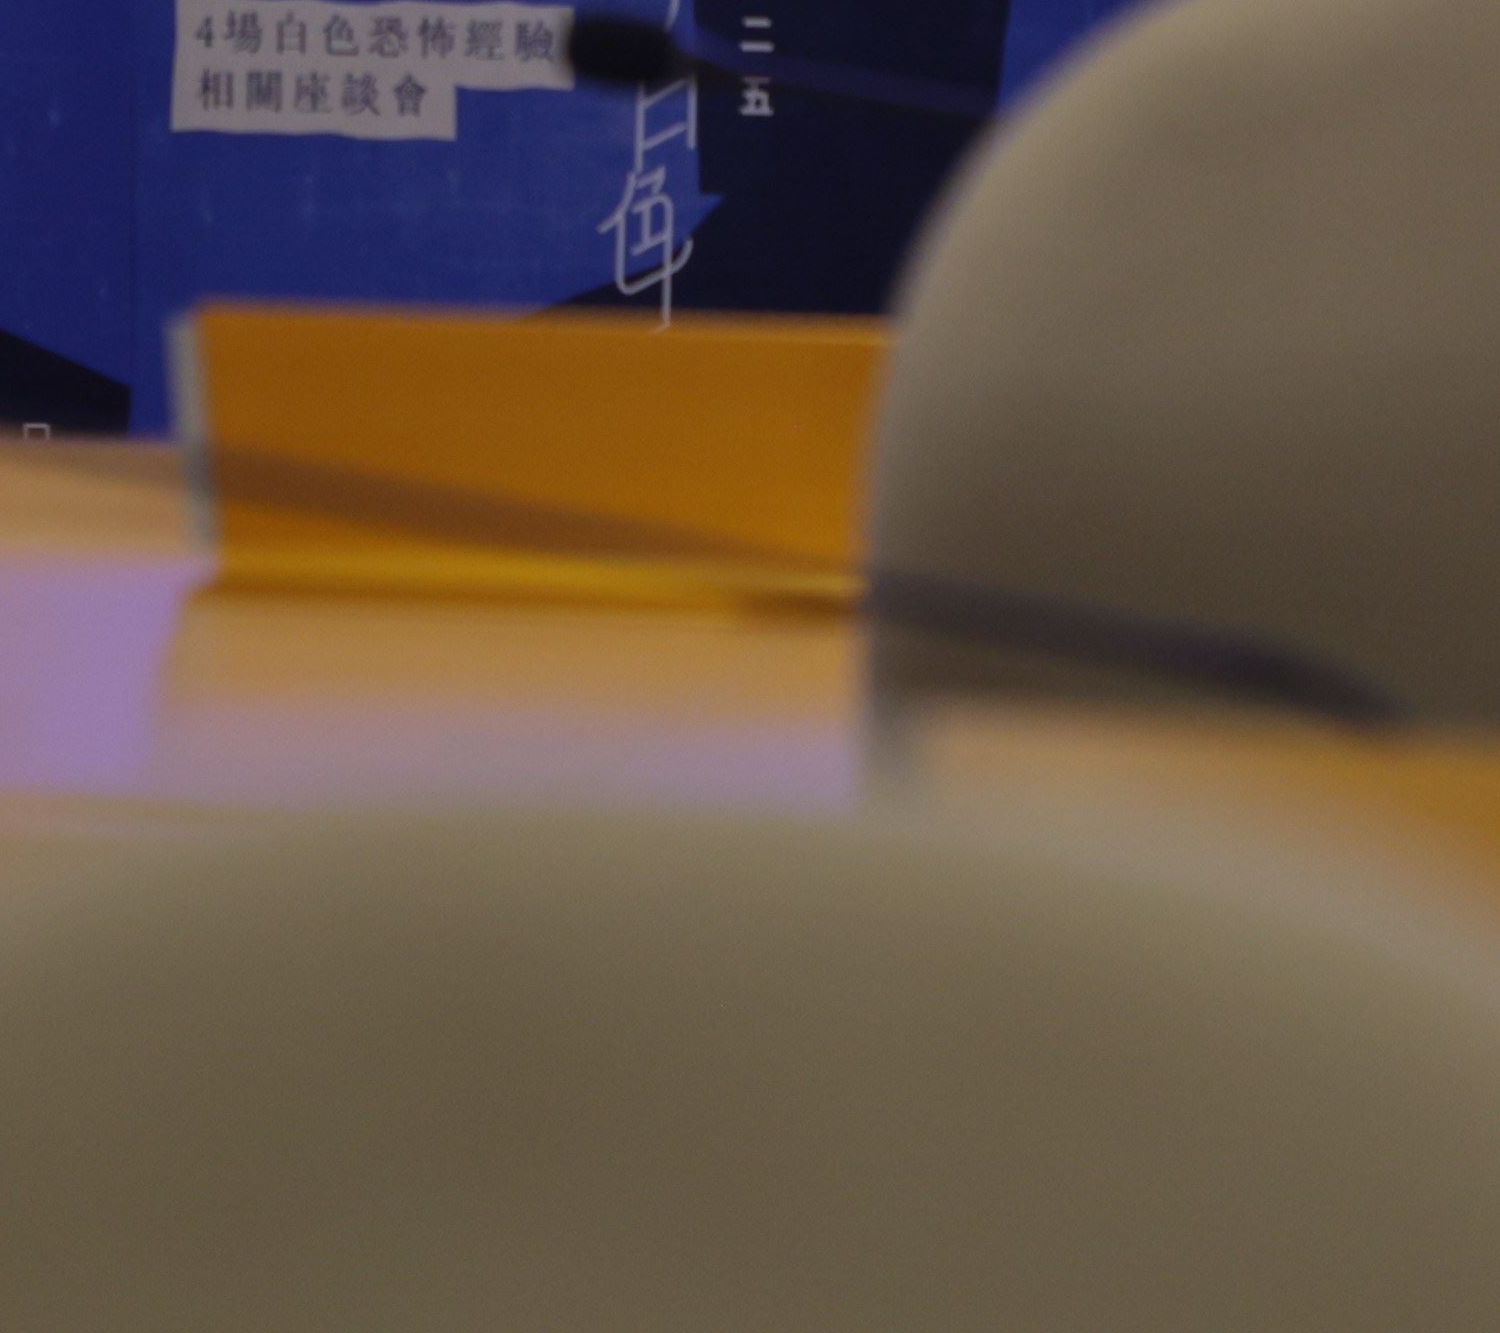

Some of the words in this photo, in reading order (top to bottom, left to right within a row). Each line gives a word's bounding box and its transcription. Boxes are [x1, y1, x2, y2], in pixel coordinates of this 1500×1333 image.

[194, 10, 558, 63] 4場白色恐怖經驗
[199, 67, 429, 118] 相關座談會
